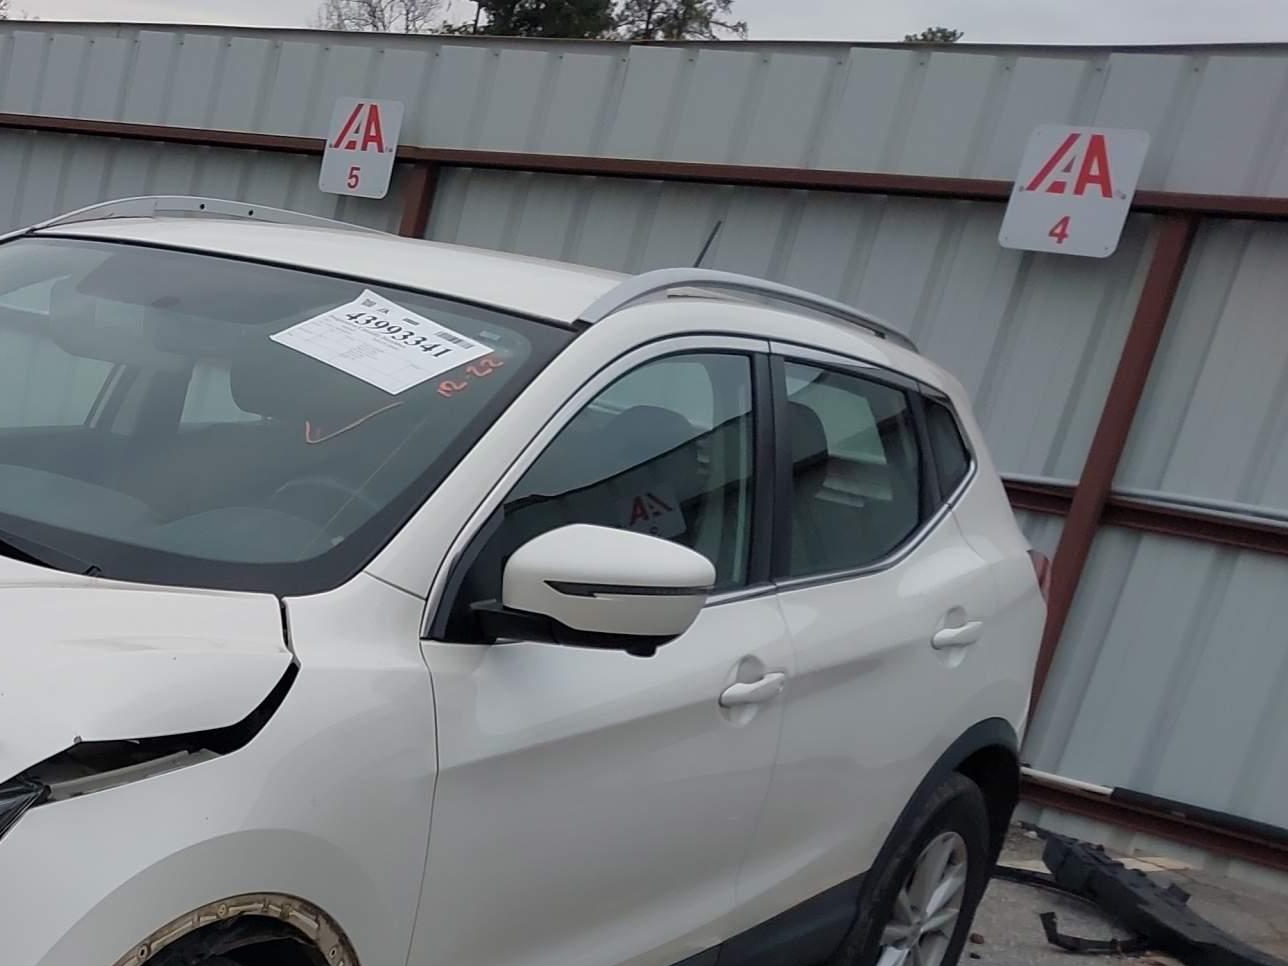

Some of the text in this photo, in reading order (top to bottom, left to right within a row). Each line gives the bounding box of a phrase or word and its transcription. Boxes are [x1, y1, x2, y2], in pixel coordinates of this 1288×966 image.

[347, 166, 361, 189] 5
[1048, 216, 1071, 244] 4
[345, 312, 453, 358] 43993341
